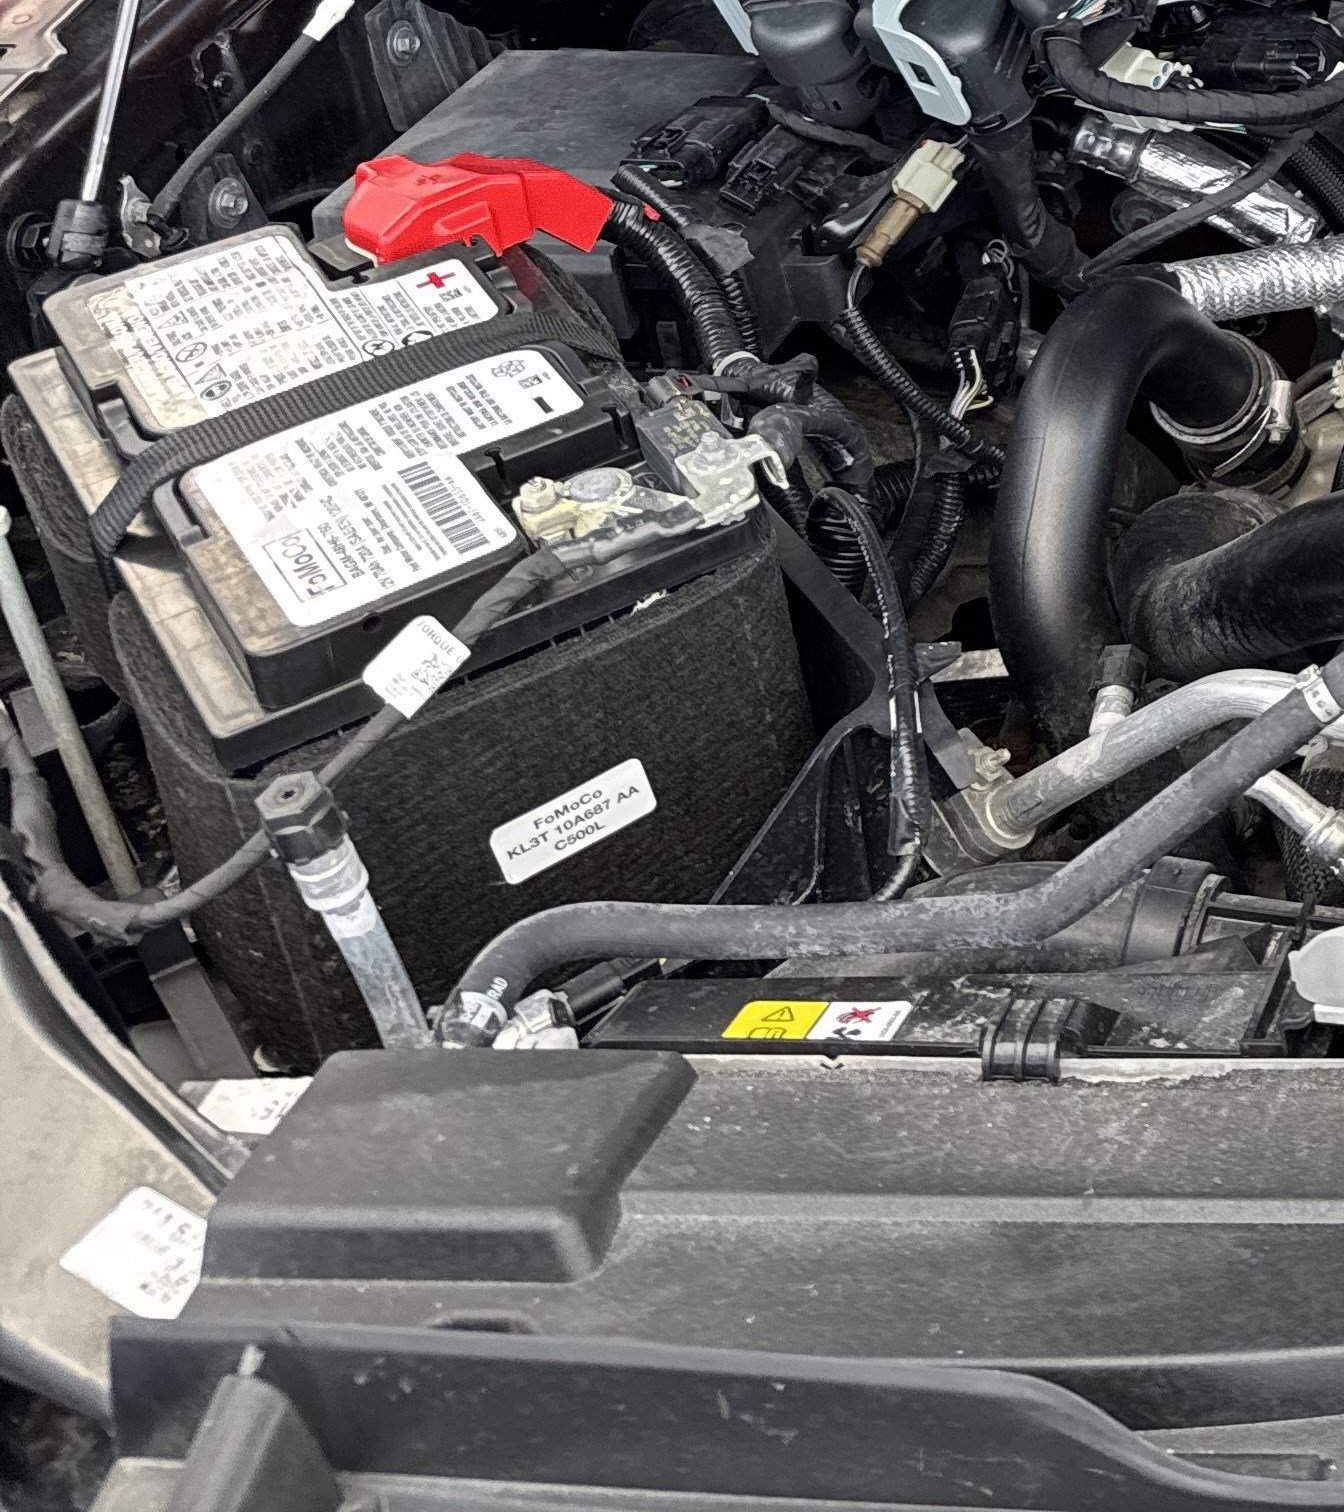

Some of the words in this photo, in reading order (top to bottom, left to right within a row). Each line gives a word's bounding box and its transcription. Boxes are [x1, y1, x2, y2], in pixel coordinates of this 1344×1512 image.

[276, 530, 332, 596] FoMoCo
[416, 620, 456, 656] TORQUE
[506, 831, 550, 860] KL3T
[554, 798, 611, 835] 10A687
[615, 785, 641, 804] AA
[532, 789, 604, 830] FoMoCo
[553, 821, 607, 852] C500L
